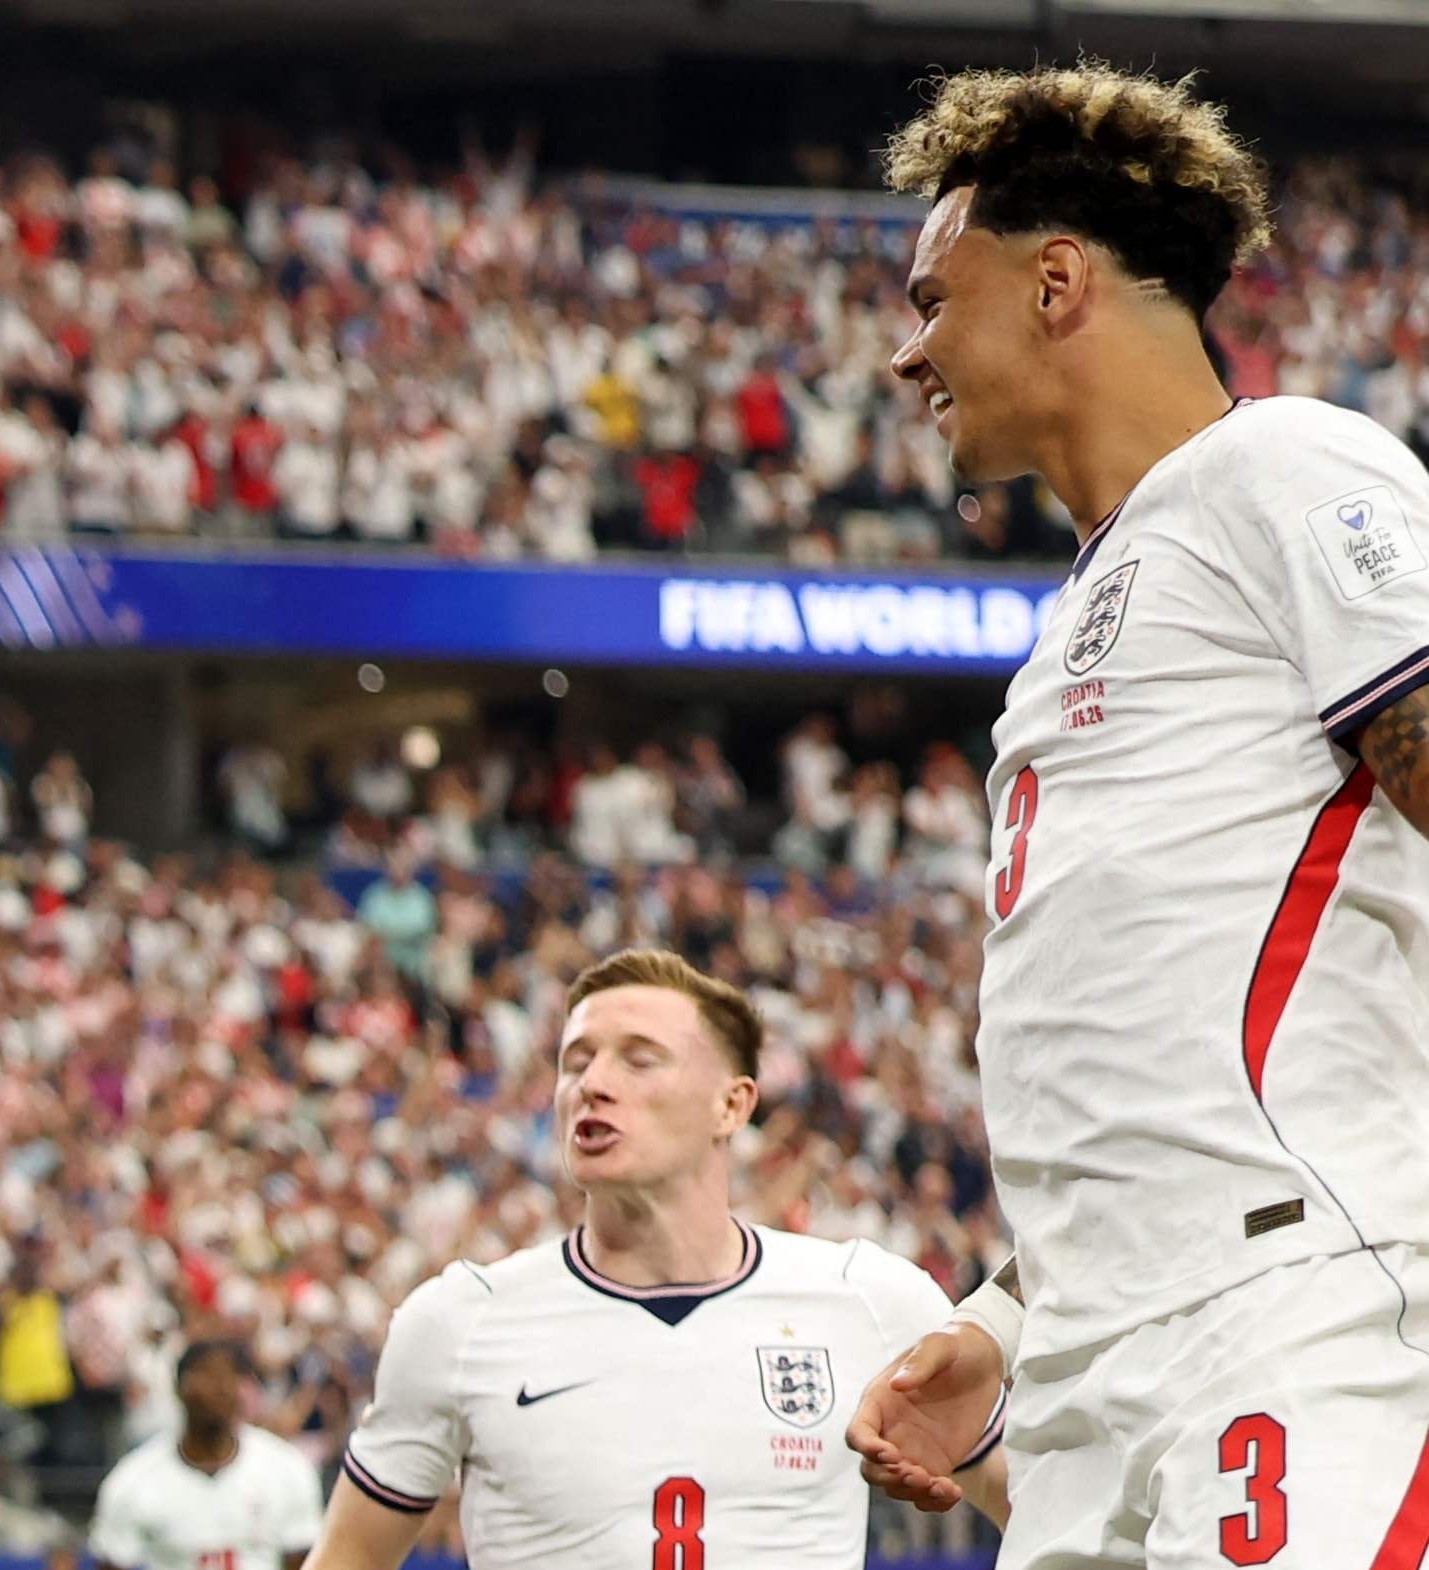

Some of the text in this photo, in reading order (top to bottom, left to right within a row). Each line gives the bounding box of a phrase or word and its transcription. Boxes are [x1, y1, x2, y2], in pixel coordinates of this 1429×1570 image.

[1354, 543, 1400, 575] PEACE
[1370, 565, 1396, 582] FIFA
[659, 579, 804, 652] FIFA
[798, 583, 1034, 658] WORLD
[1061, 681, 1104, 711] CROATIA
[1060, 705, 1104, 732] 17.06.26
[996, 765, 1038, 920] 3
[1218, 1412, 1288, 1568] 3
